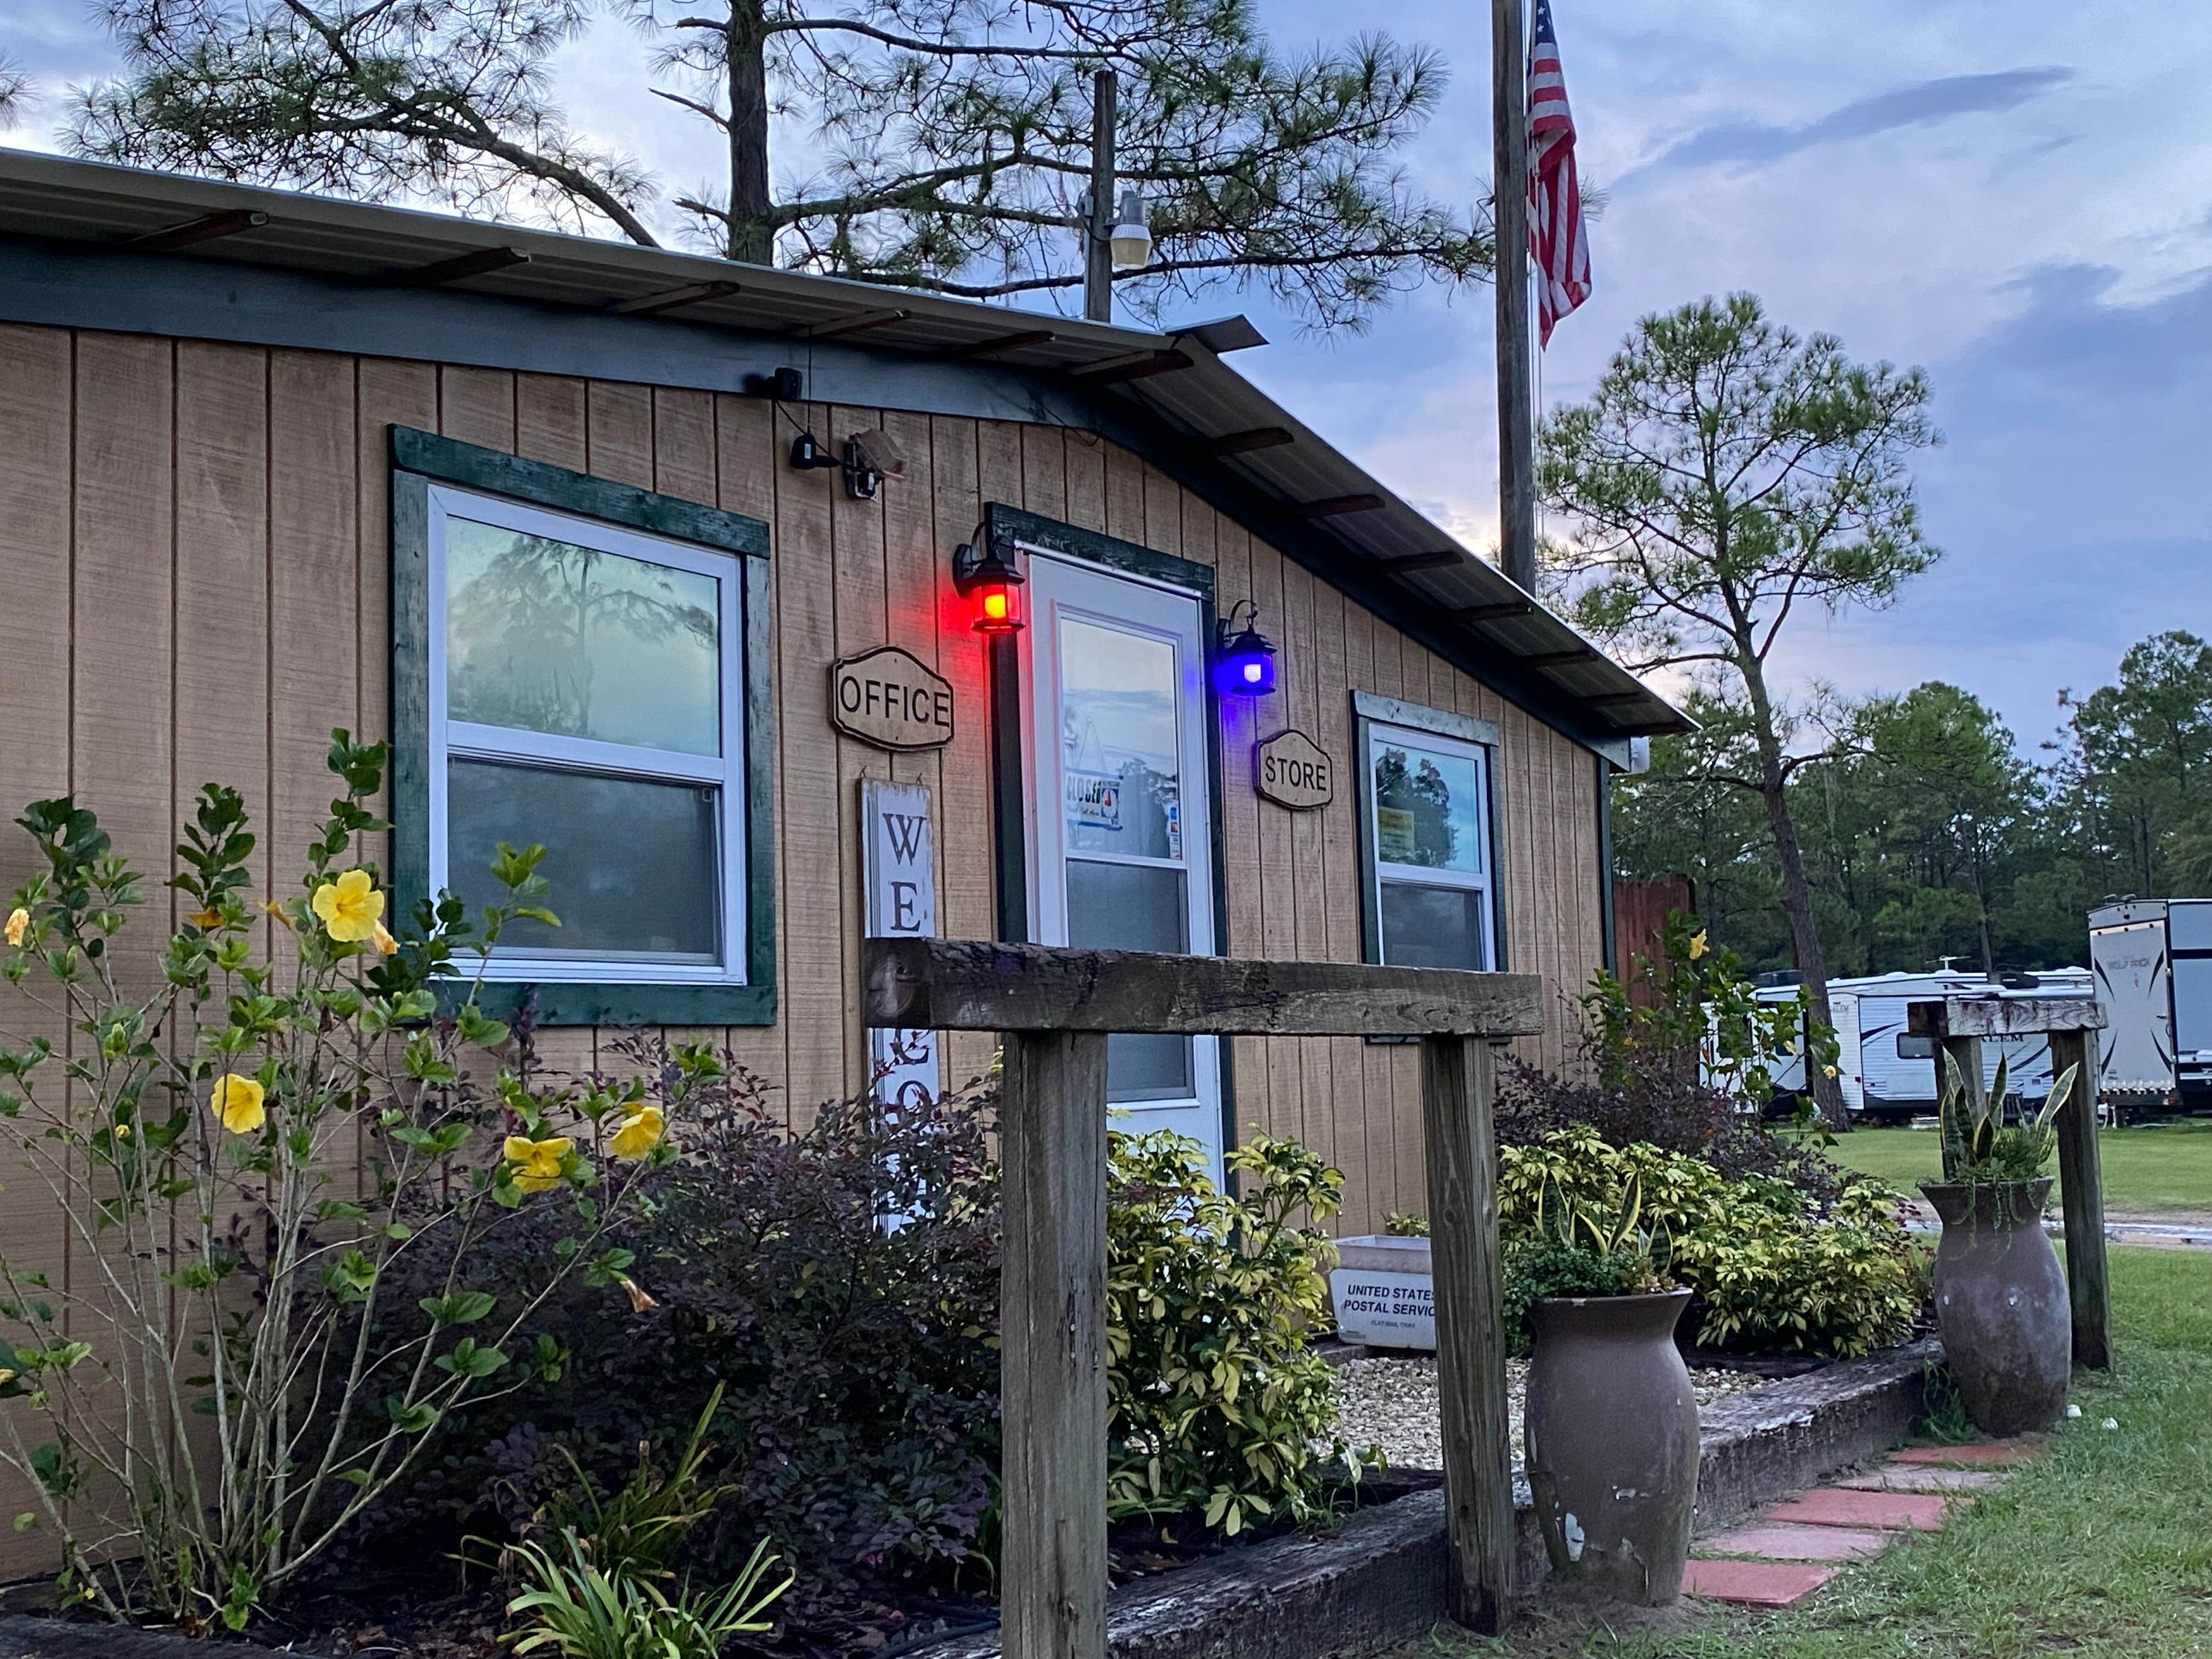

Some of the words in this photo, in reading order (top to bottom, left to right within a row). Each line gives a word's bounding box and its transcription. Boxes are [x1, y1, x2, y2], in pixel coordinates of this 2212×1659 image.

[839, 675, 950, 727] OFFICE
[1265, 755, 1327, 791] STORE
[1066, 775, 1101, 804] CLOSED
[882, 812, 932, 1141] WECO
[1347, 1284, 1389, 1298] UNITED
[1344, 1300, 1389, 1313] POSTAL
[1392, 1304, 1436, 1317] SERVIC
